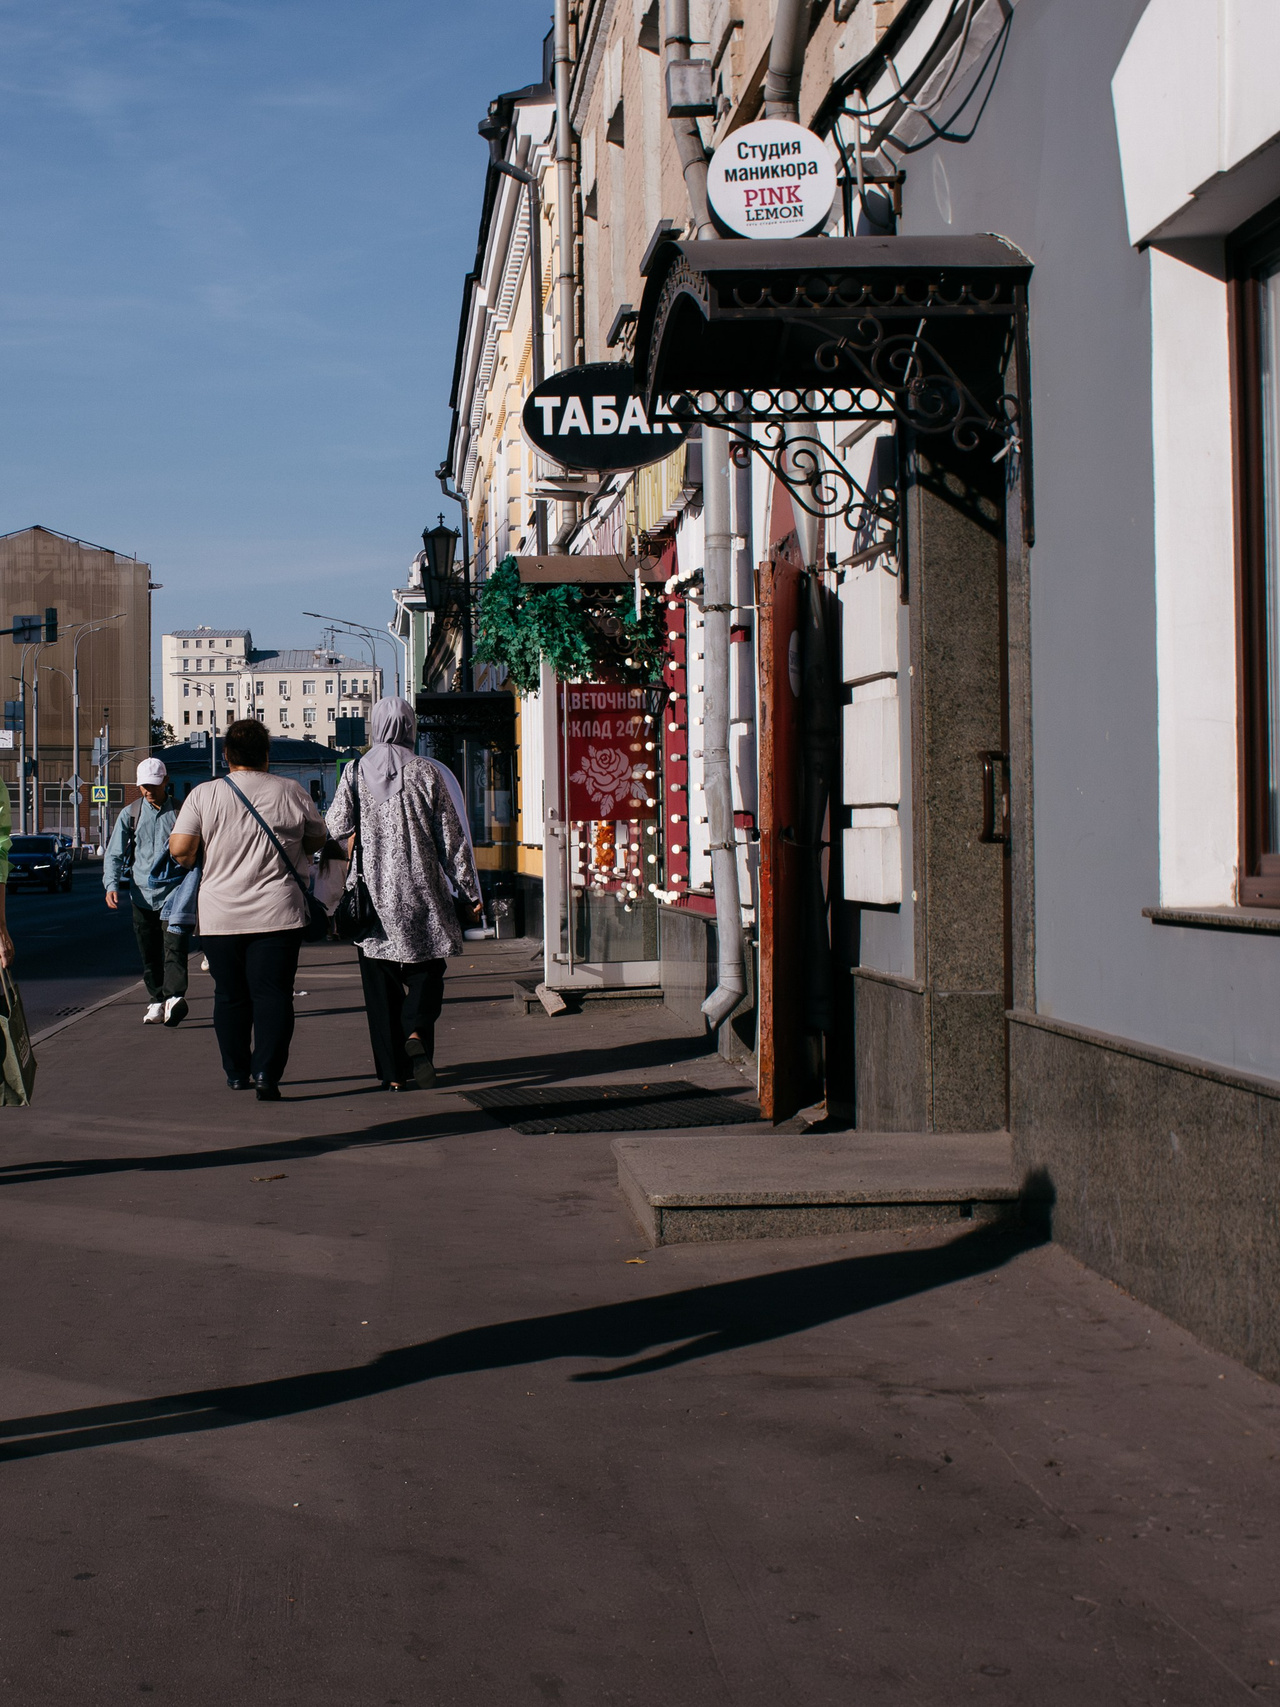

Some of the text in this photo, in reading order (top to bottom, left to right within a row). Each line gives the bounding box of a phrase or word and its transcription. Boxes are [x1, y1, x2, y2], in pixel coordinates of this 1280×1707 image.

[737, 141, 801, 162] Студия
[724, 161, 818, 182] маникюра
[743, 185, 802, 207] PINK
[745, 205, 803, 221] LEMON
[534, 396, 683, 436] ТАБАК
[562, 720, 652, 740] СКЛАД 24/7
